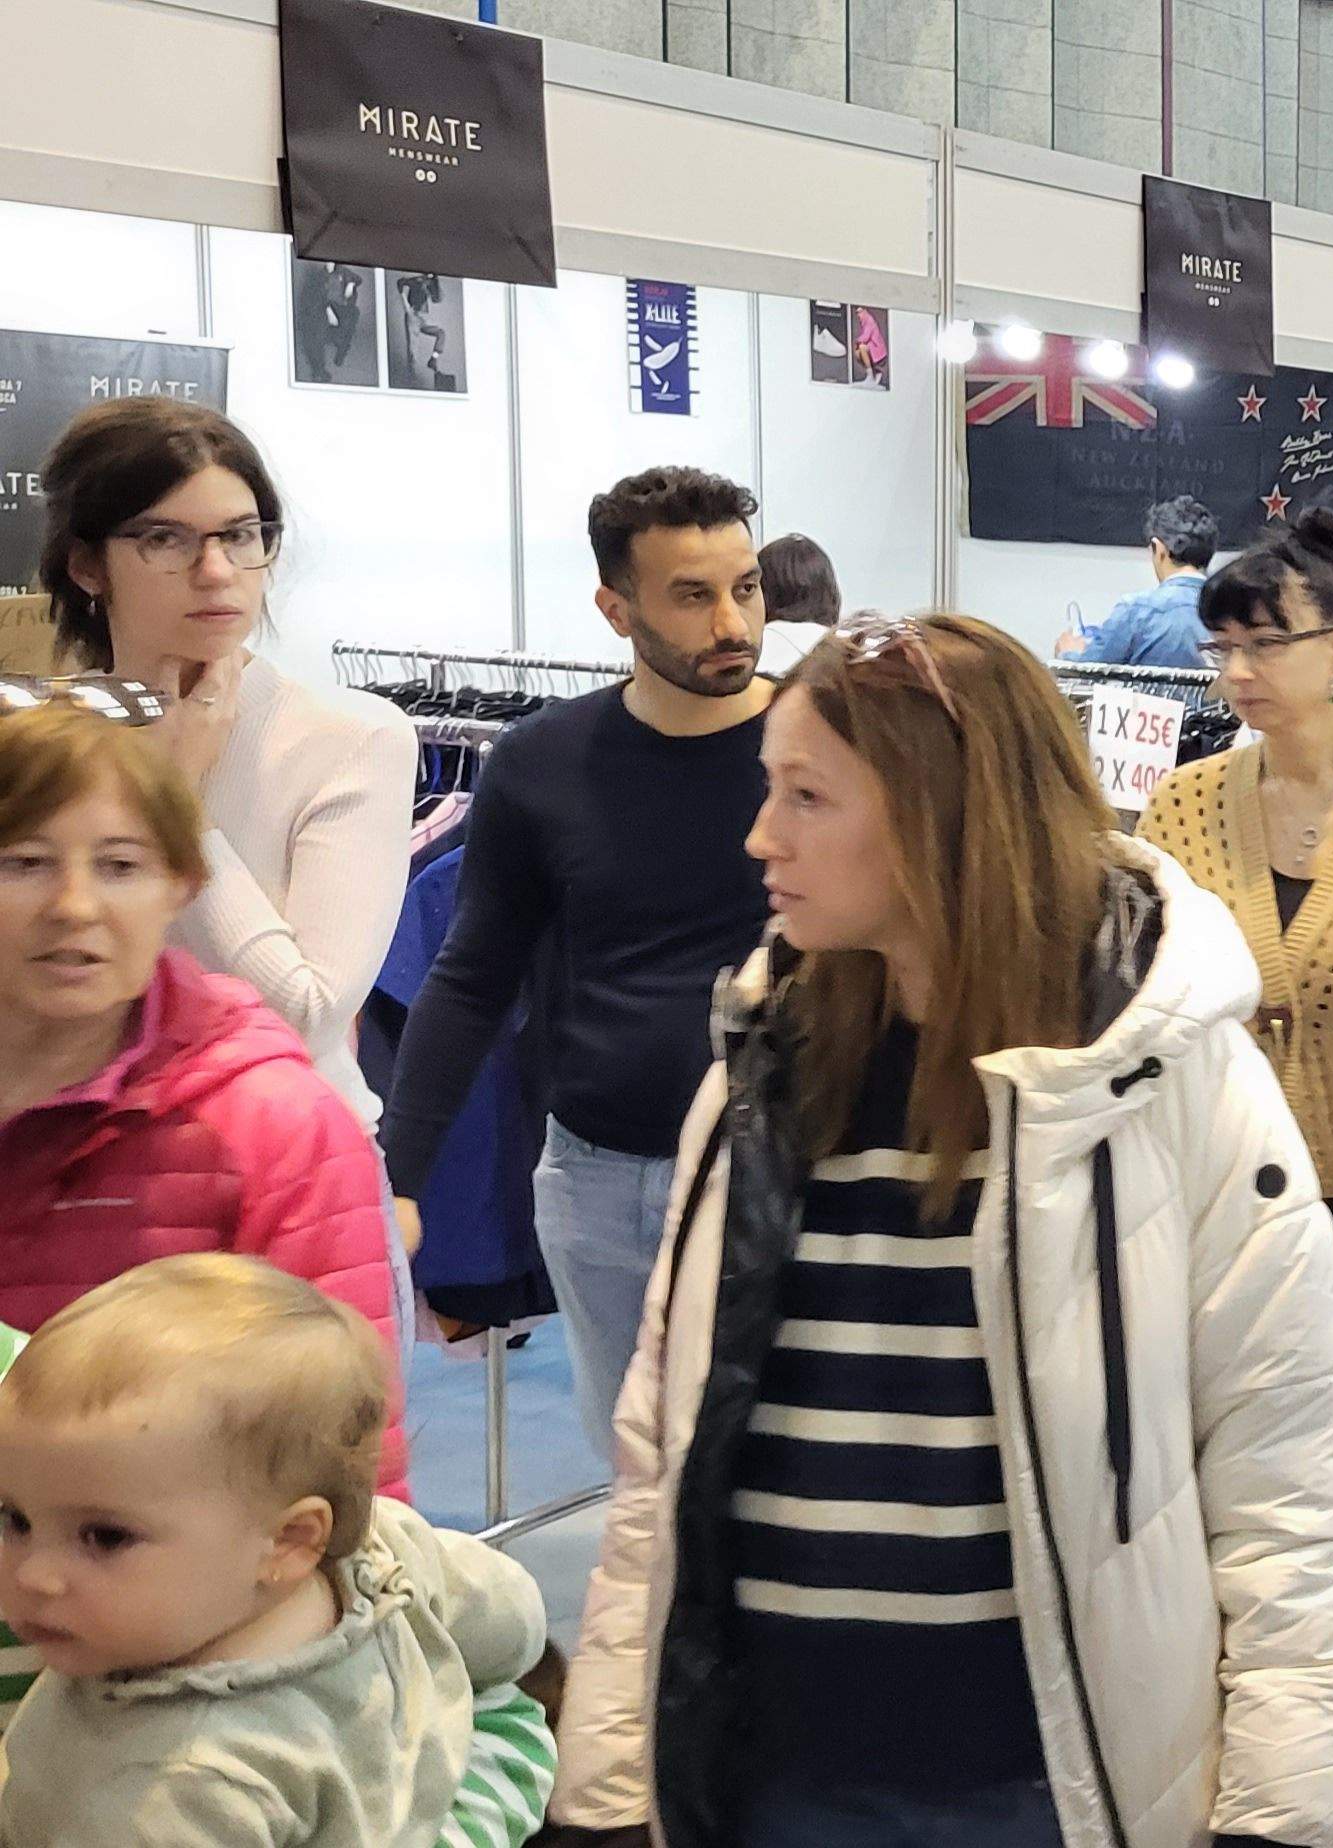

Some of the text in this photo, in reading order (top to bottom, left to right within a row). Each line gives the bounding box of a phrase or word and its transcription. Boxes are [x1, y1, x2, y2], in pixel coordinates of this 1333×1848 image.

[359, 102, 482, 151] MIRATE
[1181, 252, 1242, 283] MIRATE
[90, 376, 199, 402] MIRATE
[1097, 703, 1176, 748] 1 X 25€
[1112, 759, 1127, 792] X
